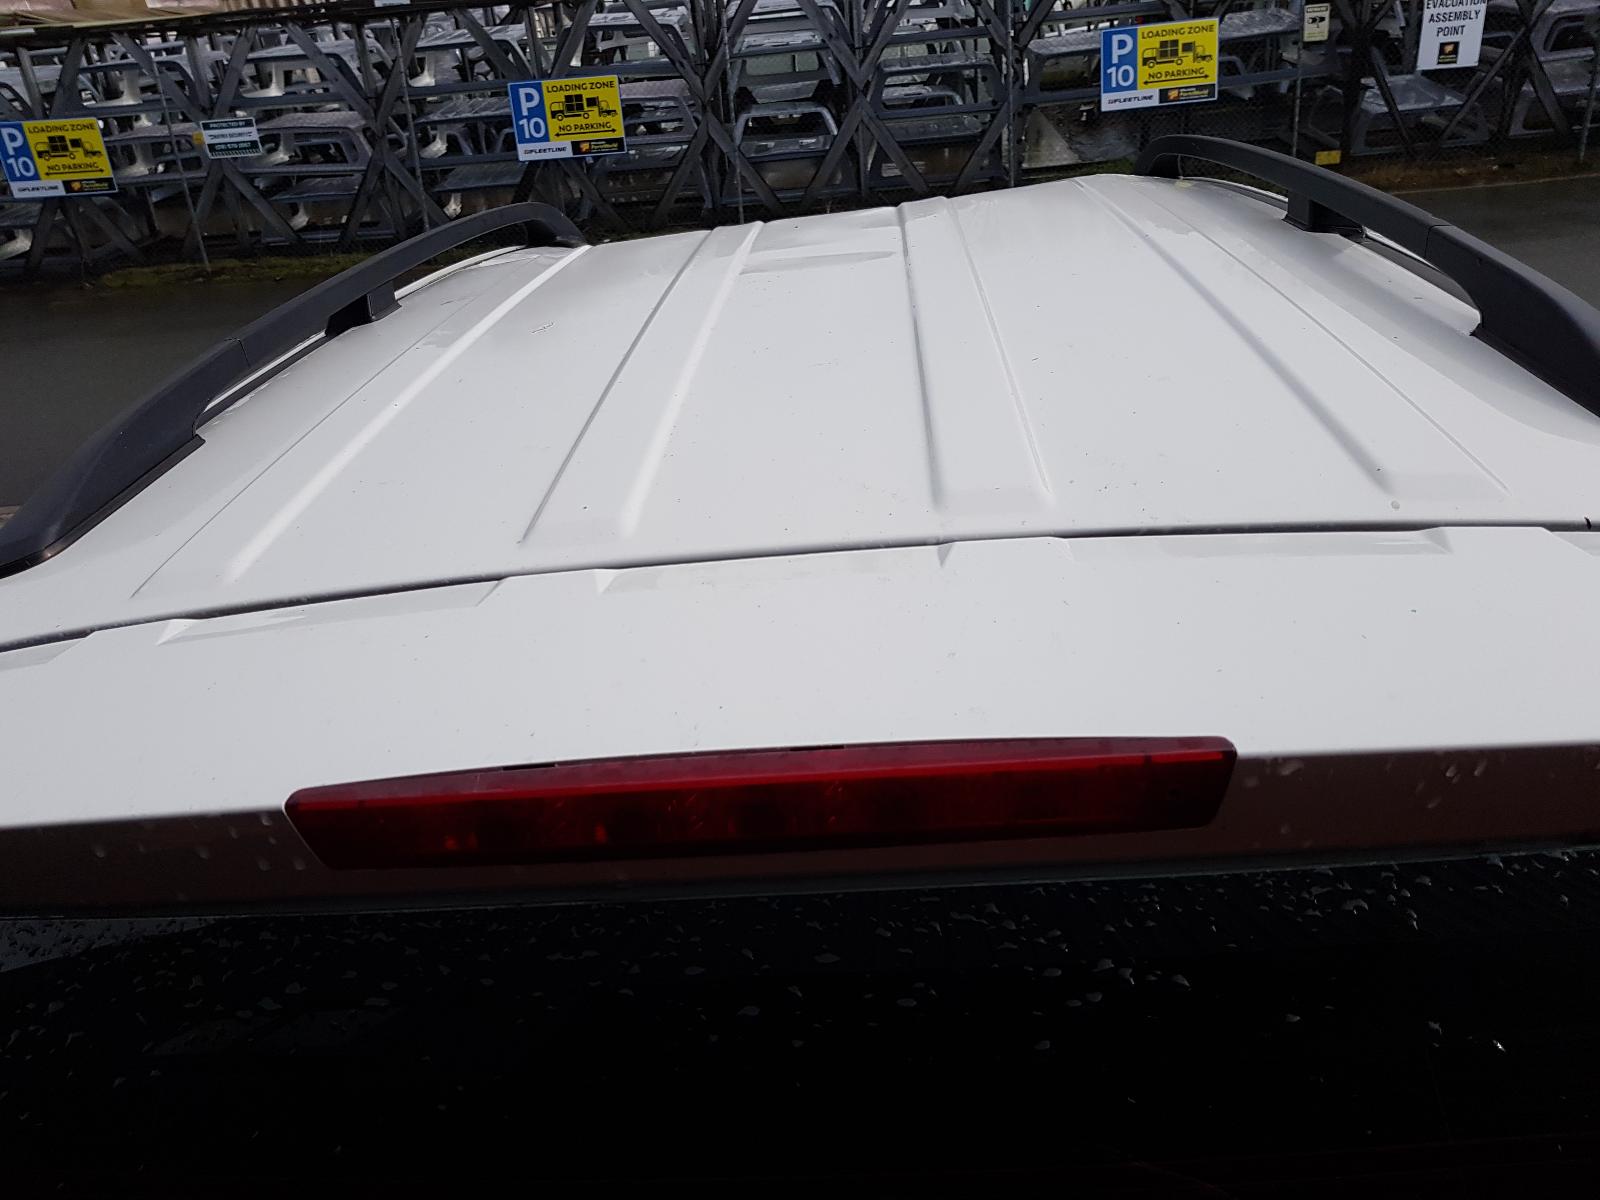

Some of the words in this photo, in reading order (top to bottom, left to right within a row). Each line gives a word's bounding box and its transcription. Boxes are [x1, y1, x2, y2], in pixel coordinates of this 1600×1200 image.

[1428, 10, 1481, 23] ASSEMBLY
[1142, 28, 1185, 39] LOADING
[1188, 24, 1214, 34] ZONE
[1436, 25, 1464, 37] POINT
[1112, 34, 1133, 64] P
[1107, 65, 1134, 88] 10
[1148, 71, 1162, 80] NO
[1164, 67, 1204, 78] PARKING
[546, 83, 588, 93] LOADING
[590, 80, 615, 90] ZONE
[518, 87, 540, 116] P
[29, 124, 69, 134] LOADING
[70, 123, 95, 132] ZONE
[518, 118, 546, 139] 10
[558, 124, 572, 132] NO
[574, 122, 612, 132] PARKING
[1, 127, 24, 156] P
[7, 158, 36, 178] 10
[46, 162, 60, 172] NO
[61, 160, 100, 170] PARKING
